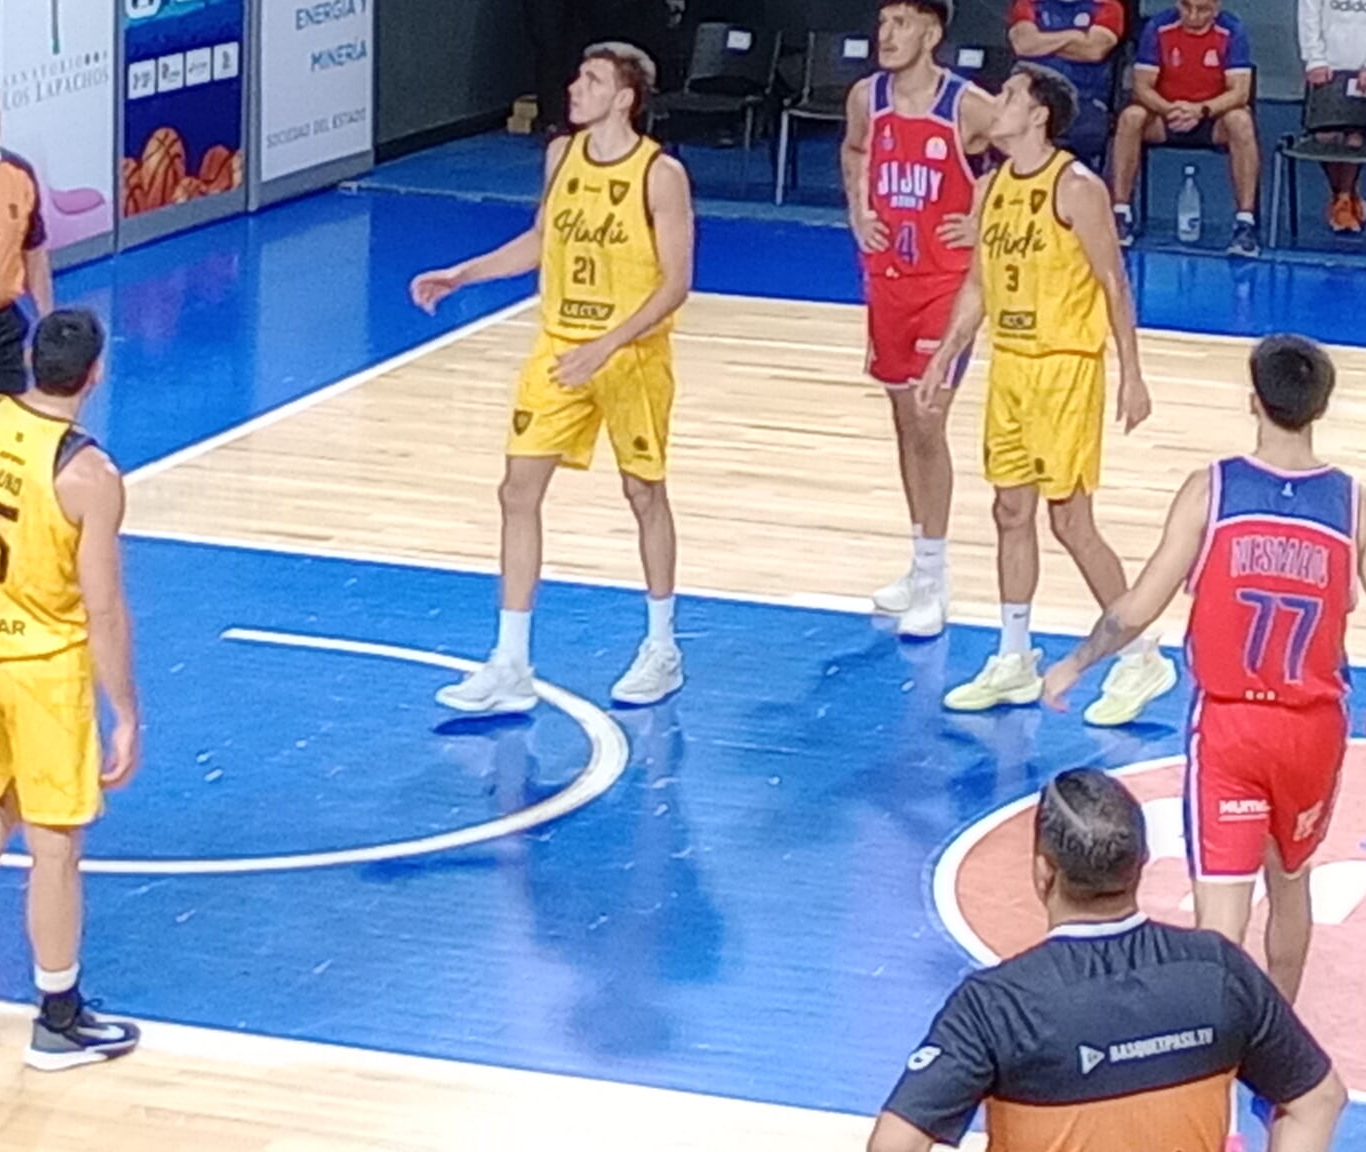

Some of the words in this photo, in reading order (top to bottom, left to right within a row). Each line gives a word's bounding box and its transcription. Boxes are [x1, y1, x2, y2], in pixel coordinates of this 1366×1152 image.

[573, 256, 596, 286] 21
[1005, 265, 1019, 292] 3
[1235, 588, 1323, 685] 77
